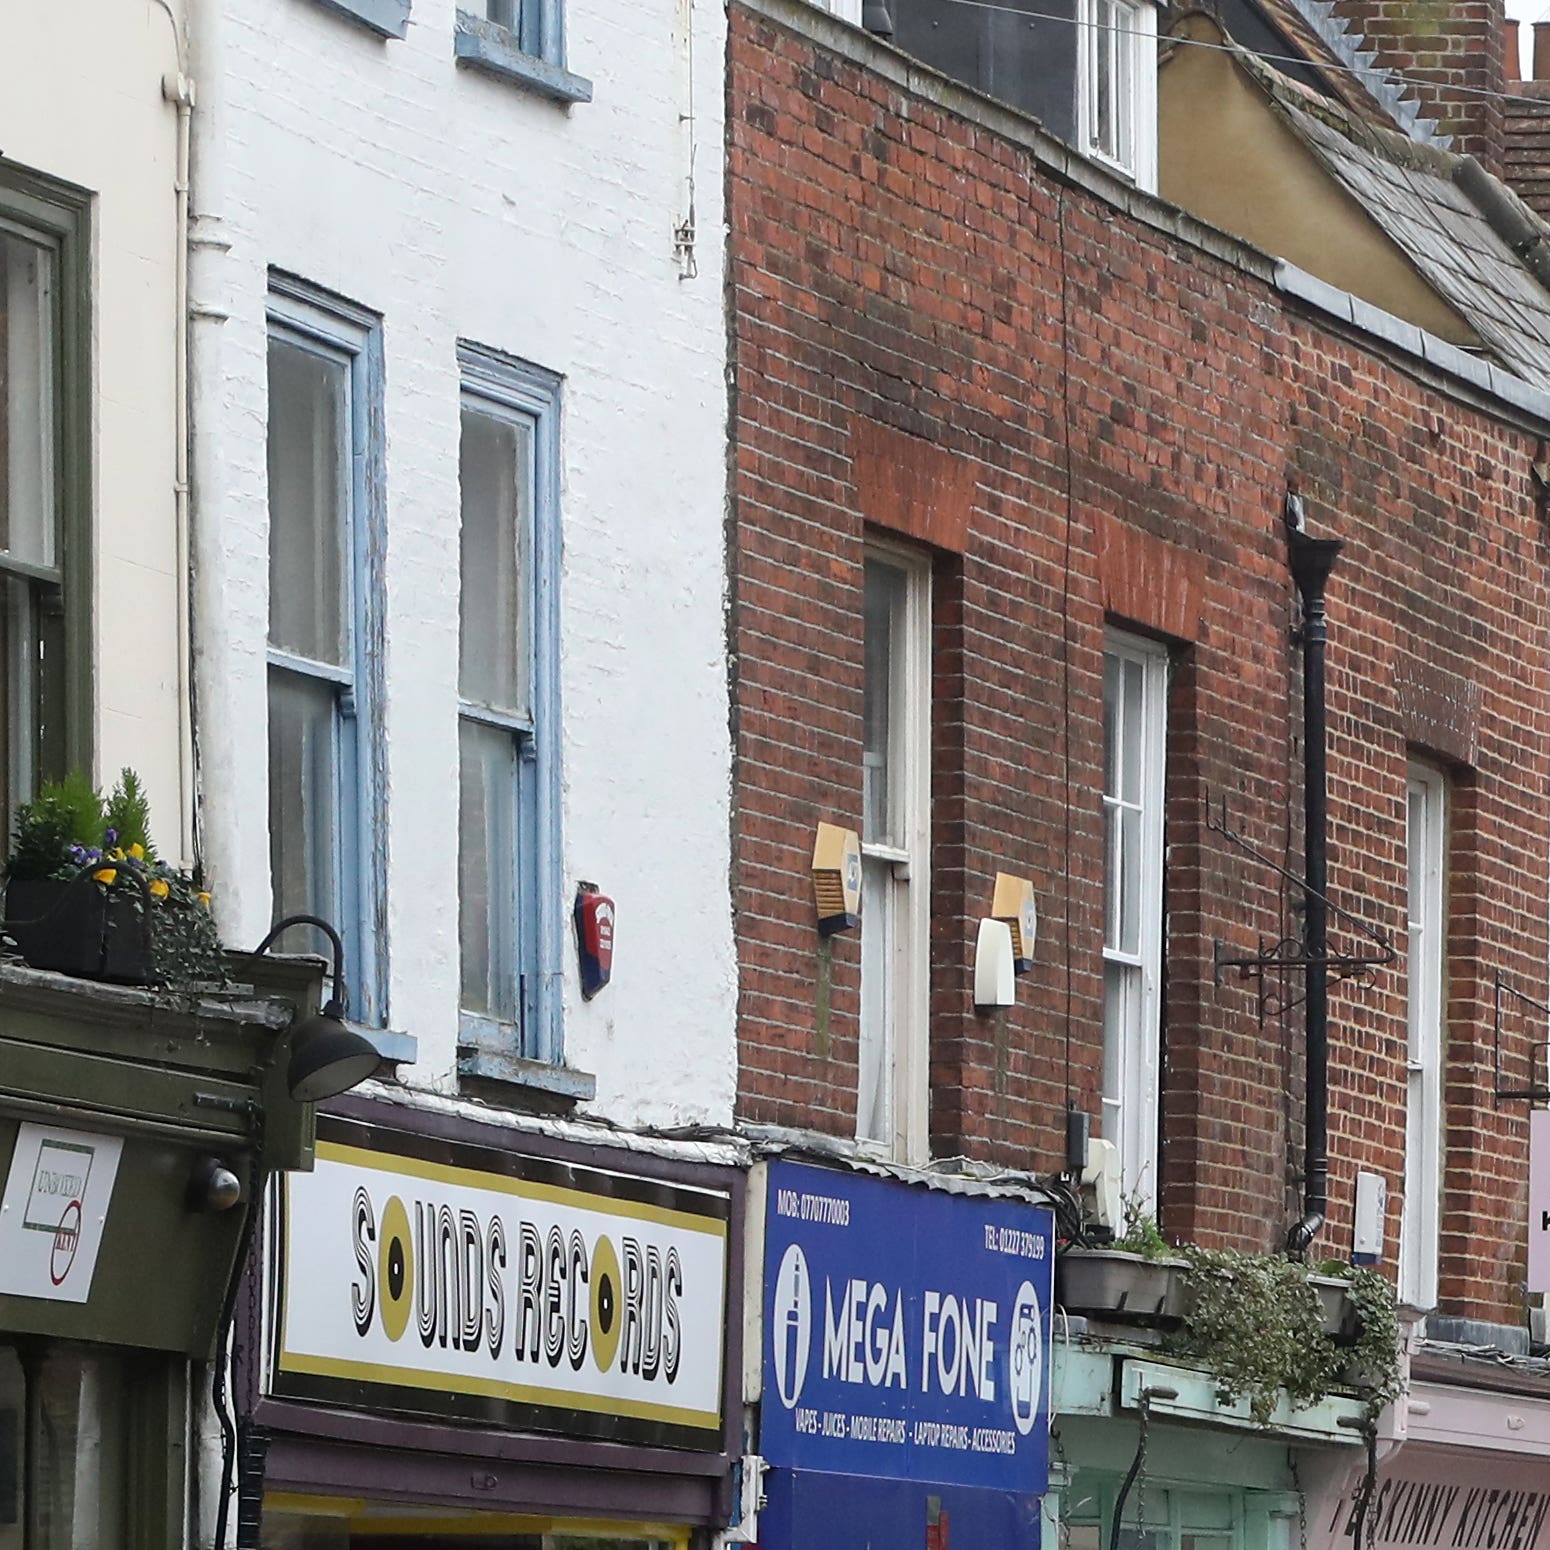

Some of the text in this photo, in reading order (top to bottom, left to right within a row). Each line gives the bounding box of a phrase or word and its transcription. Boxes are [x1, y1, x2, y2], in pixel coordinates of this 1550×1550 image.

[515, 1221, 682, 1386] RECORDS
[822, 1274, 998, 1402] MEGA FONE
